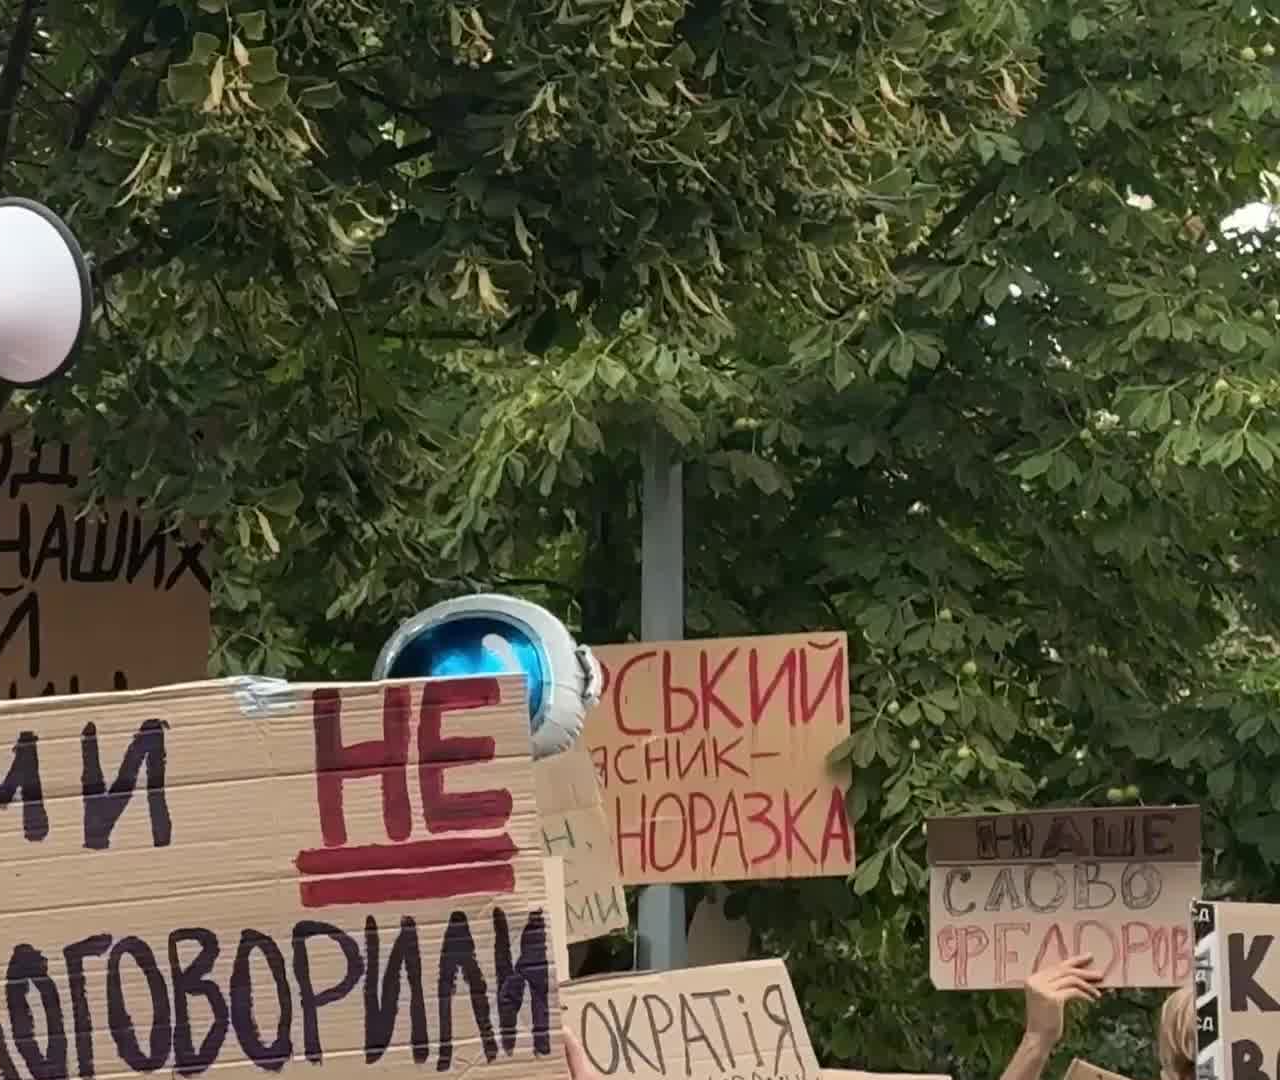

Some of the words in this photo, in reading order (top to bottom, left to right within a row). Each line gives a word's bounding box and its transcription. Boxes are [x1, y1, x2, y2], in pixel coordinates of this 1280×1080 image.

[310, 677, 517, 849] НЕ
[615, 785, 853, 877] НОРАЗКА
[975, 815, 1177, 860] НАШЕ
[942, 859, 1163, 917] СЛОВО
